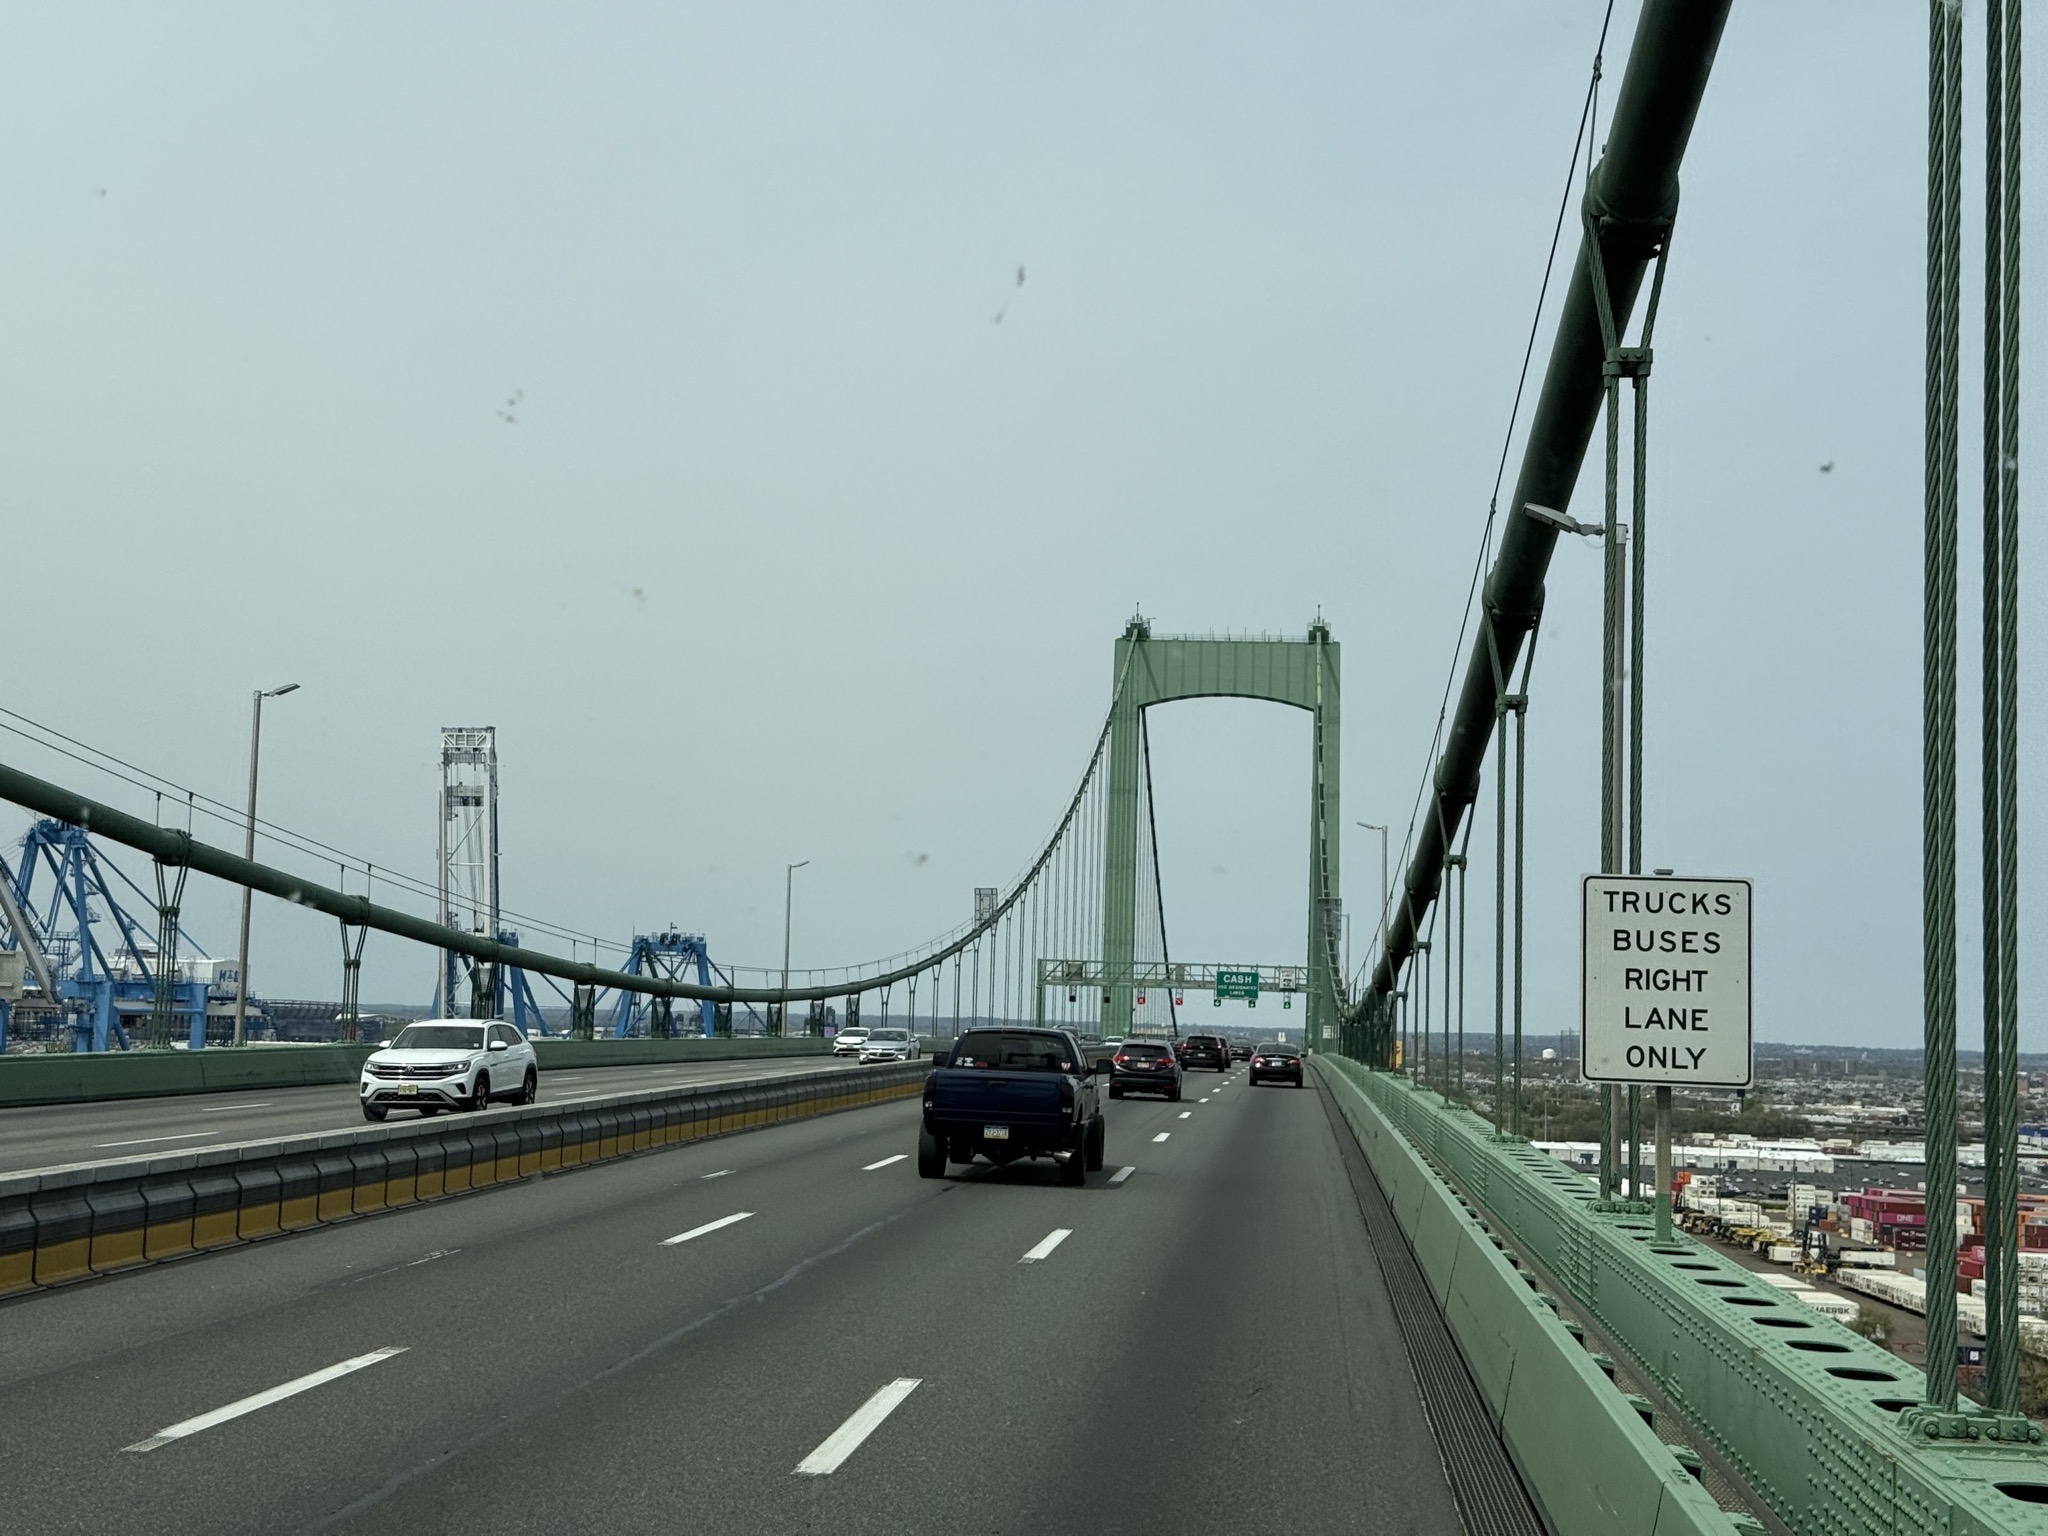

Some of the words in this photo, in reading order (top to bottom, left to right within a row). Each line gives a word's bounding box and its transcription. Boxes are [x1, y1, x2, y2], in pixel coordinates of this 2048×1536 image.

[1603, 890, 1732, 916] TRUCKS
[1613, 928, 1721, 954] BUSES
[1223, 974, 1252, 984] CASH
[1624, 967, 1709, 993] RIGHT
[1624, 1006, 1709, 1032] LANE
[1626, 1044, 1708, 1070] ONLY
[1896, 1214, 1914, 1222] ONE
